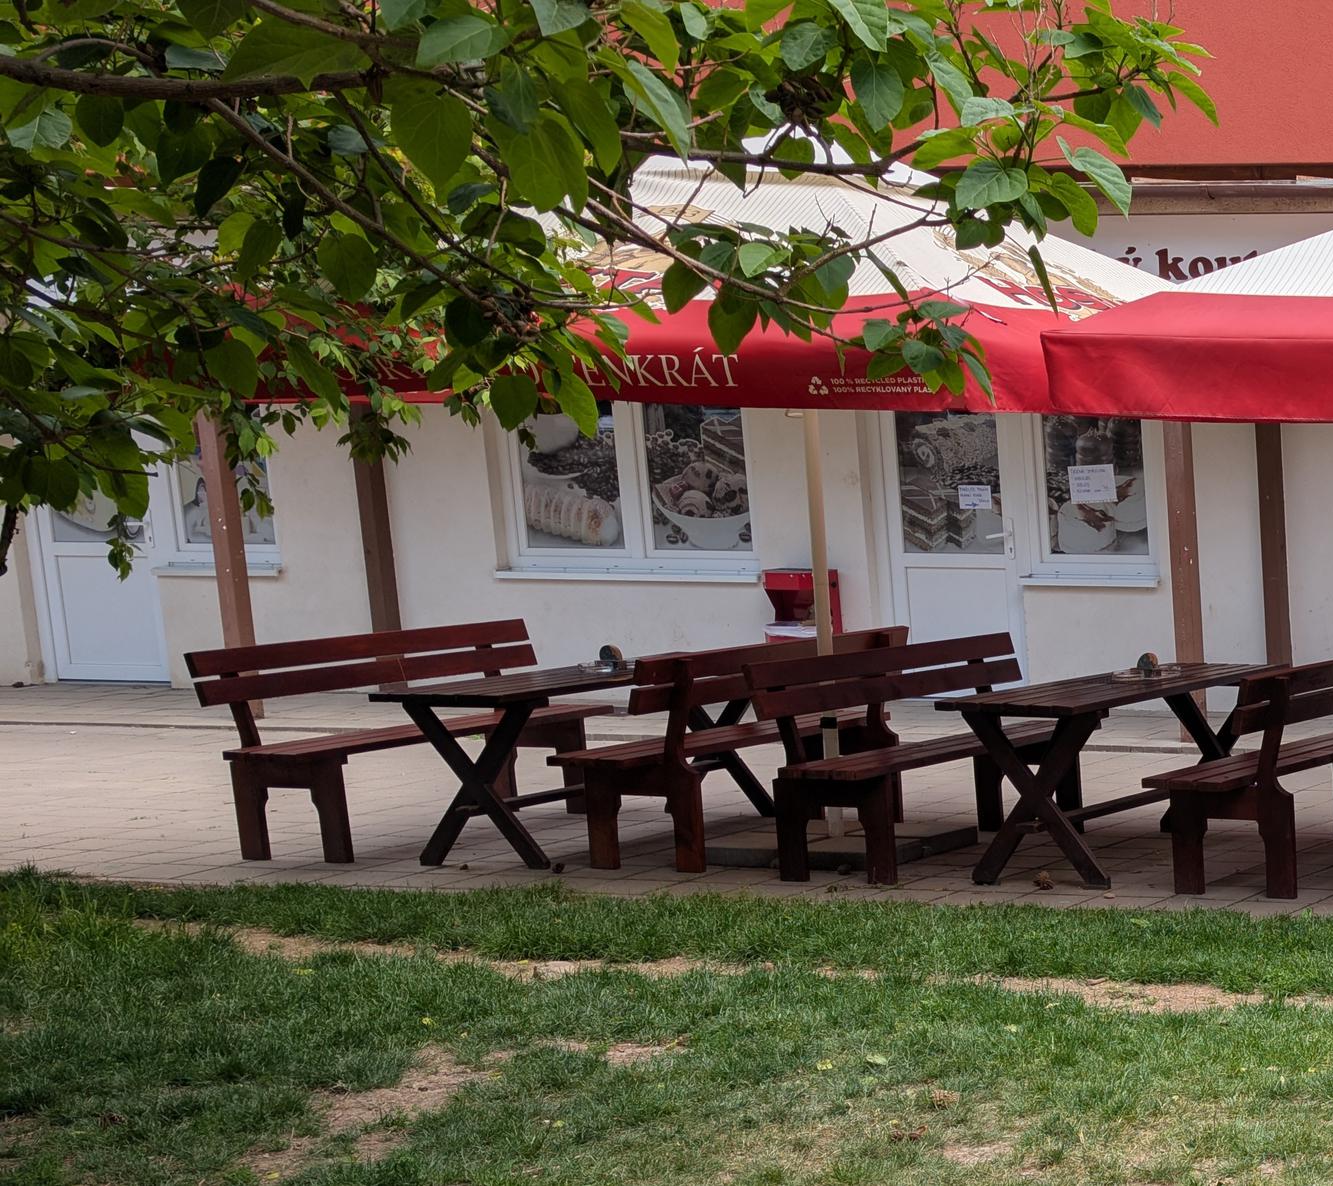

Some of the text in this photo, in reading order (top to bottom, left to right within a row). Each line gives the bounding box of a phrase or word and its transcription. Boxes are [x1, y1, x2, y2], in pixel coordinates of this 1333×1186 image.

[572, 347, 740, 388] ENKRÁT
[856, 384, 912, 394] RECYKLOVANÝ
[913, 386, 933, 394] PLAS
